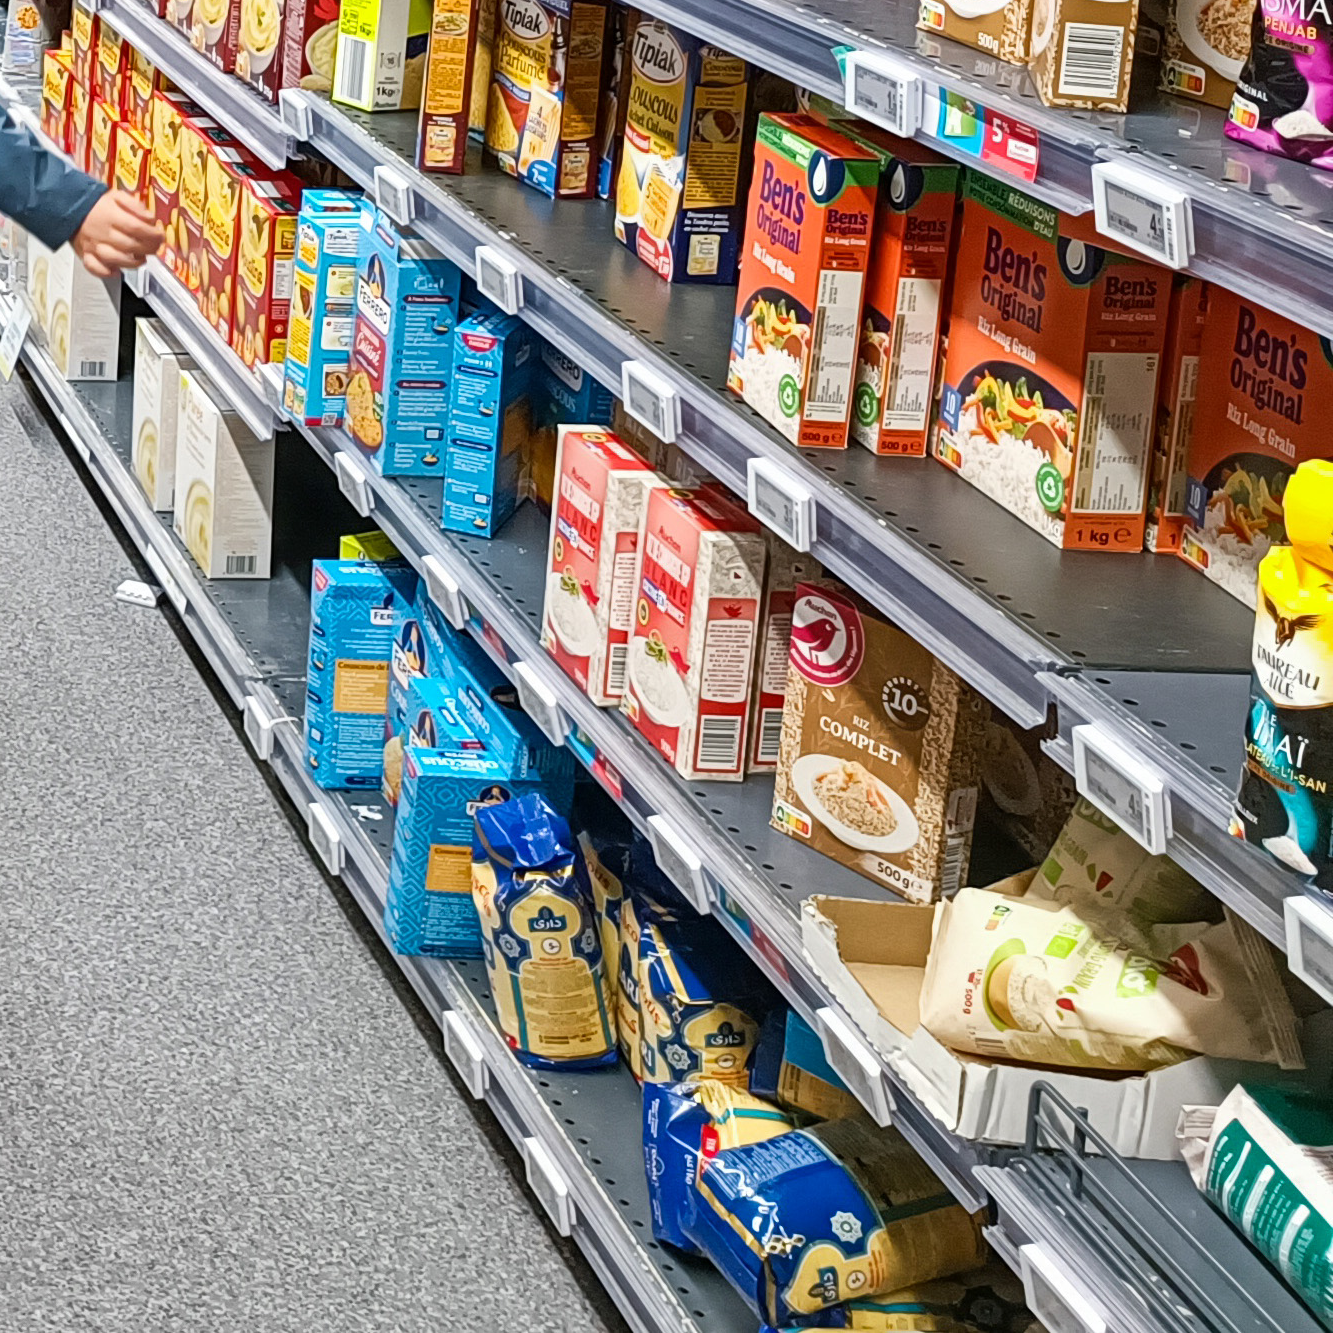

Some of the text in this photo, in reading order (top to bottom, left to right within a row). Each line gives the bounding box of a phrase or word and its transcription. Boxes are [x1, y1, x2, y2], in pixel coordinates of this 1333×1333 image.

[504, 0, 543, 34] Tipiak
[1265, 16, 1317, 39] PENJAB
[502, 33, 546, 63] Couscous
[636, 30, 676, 75] Tipiak
[500, 48, 545, 80] Parfumé
[761, 160, 805, 225] Ben's
[828, 209, 868, 225] Ben's
[1009, 193, 1055, 225] RÉDUISONS
[757, 204, 800, 255] Original
[826, 225, 866, 235] Original
[907, 217, 946, 232] Ben's
[1034, 222, 1053, 237] D'EAU
[984, 226, 1046, 301] Ben's
[1105, 276, 1157, 296] Ben's
[981, 275, 1042, 333] Original
[1103, 297, 1155, 309] Original
[977, 315, 1036, 363] Riz Long Grain
[1234, 306, 1307, 390] Ben's
[944, 389, 955, 412] 10
[1230, 358, 1303, 425] Original
[802, 432, 819, 442] 500
[1227, 403, 1296, 458] Riz Long Grain
[881, 441, 897, 451] 500
[1090, 529, 1108, 544] kg
[805, 597, 838, 621] Auchan
[890, 689, 916, 714] 10
[852, 714, 869, 728] RIZ
[820, 715, 901, 766] COMPLET
